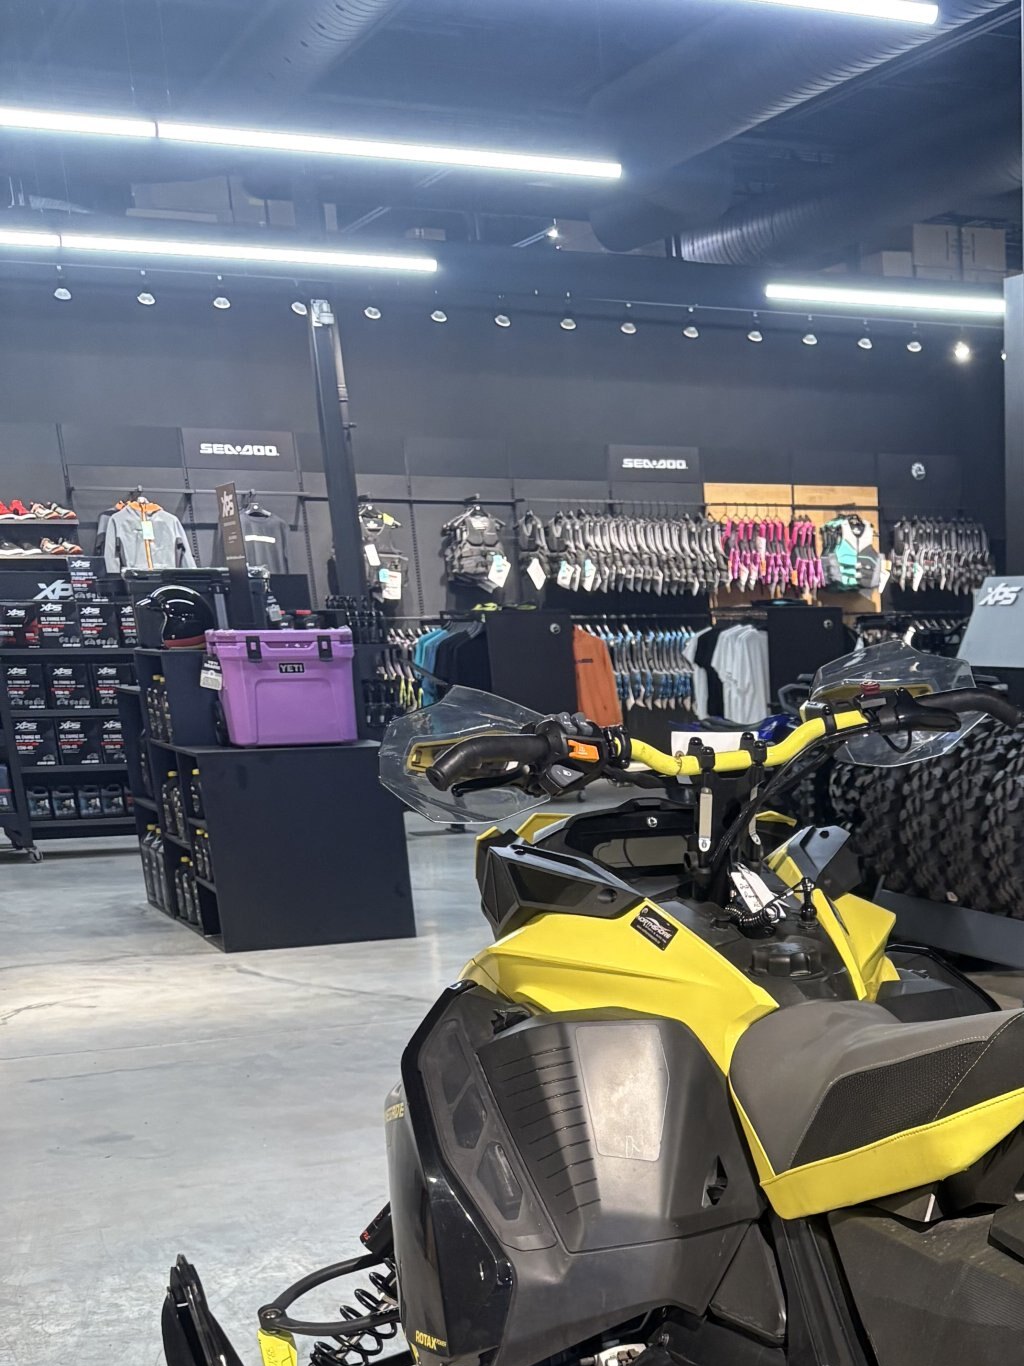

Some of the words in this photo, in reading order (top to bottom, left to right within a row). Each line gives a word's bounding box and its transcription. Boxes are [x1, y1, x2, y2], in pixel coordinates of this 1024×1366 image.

[71, 560, 91, 569] XPS
[33, 580, 74, 600] XP
[978, 582, 1023, 606] XPS
[40, 603, 63, 612] XPS
[80, 606, 101, 615] XPS
[7, 667, 27, 676] XPS
[52, 667, 73, 676] XPS
[97, 666, 117, 675] XPS
[279, 664, 304, 673] YETI
[14, 721, 37, 730] XPS
[59, 720, 81, 729] XPS
[415, 1330, 437, 1351] ROTAX
